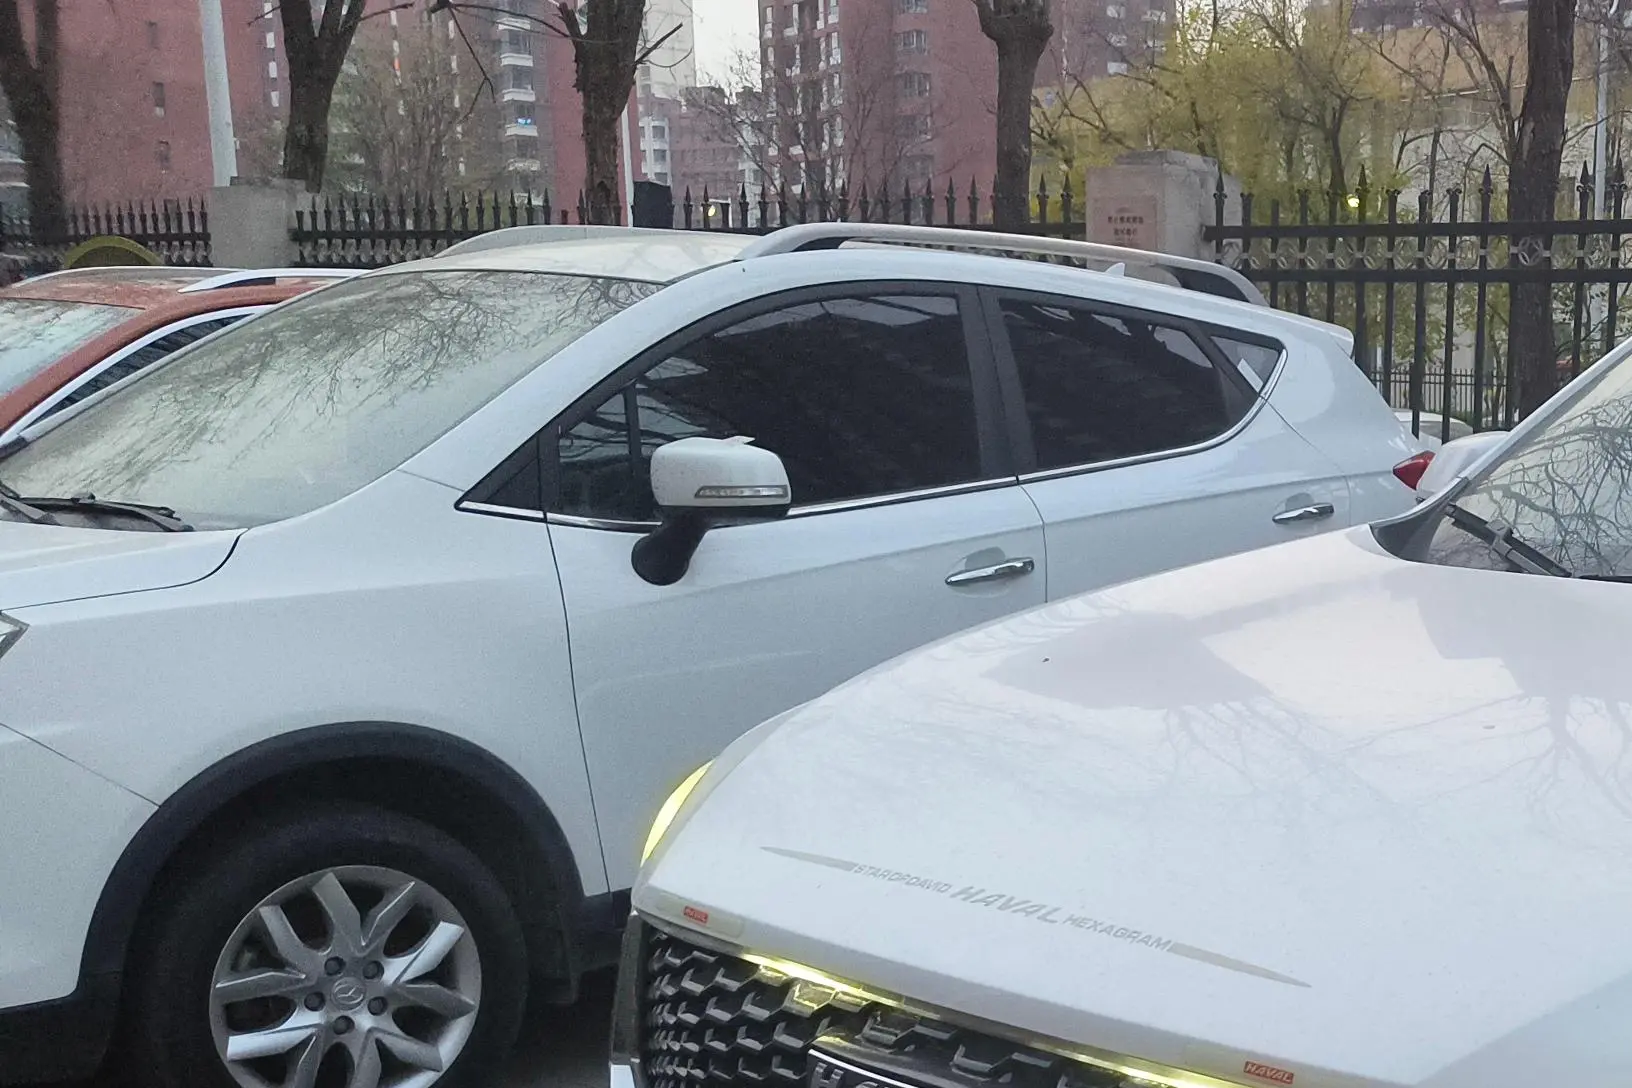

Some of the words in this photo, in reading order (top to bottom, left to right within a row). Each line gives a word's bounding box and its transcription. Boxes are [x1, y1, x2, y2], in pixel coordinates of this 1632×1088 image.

[950, 885, 1058, 924] HAVAL
[1062, 913, 1172, 952] HEXAGRAM
[1245, 1061, 1293, 1083] HAVAL
